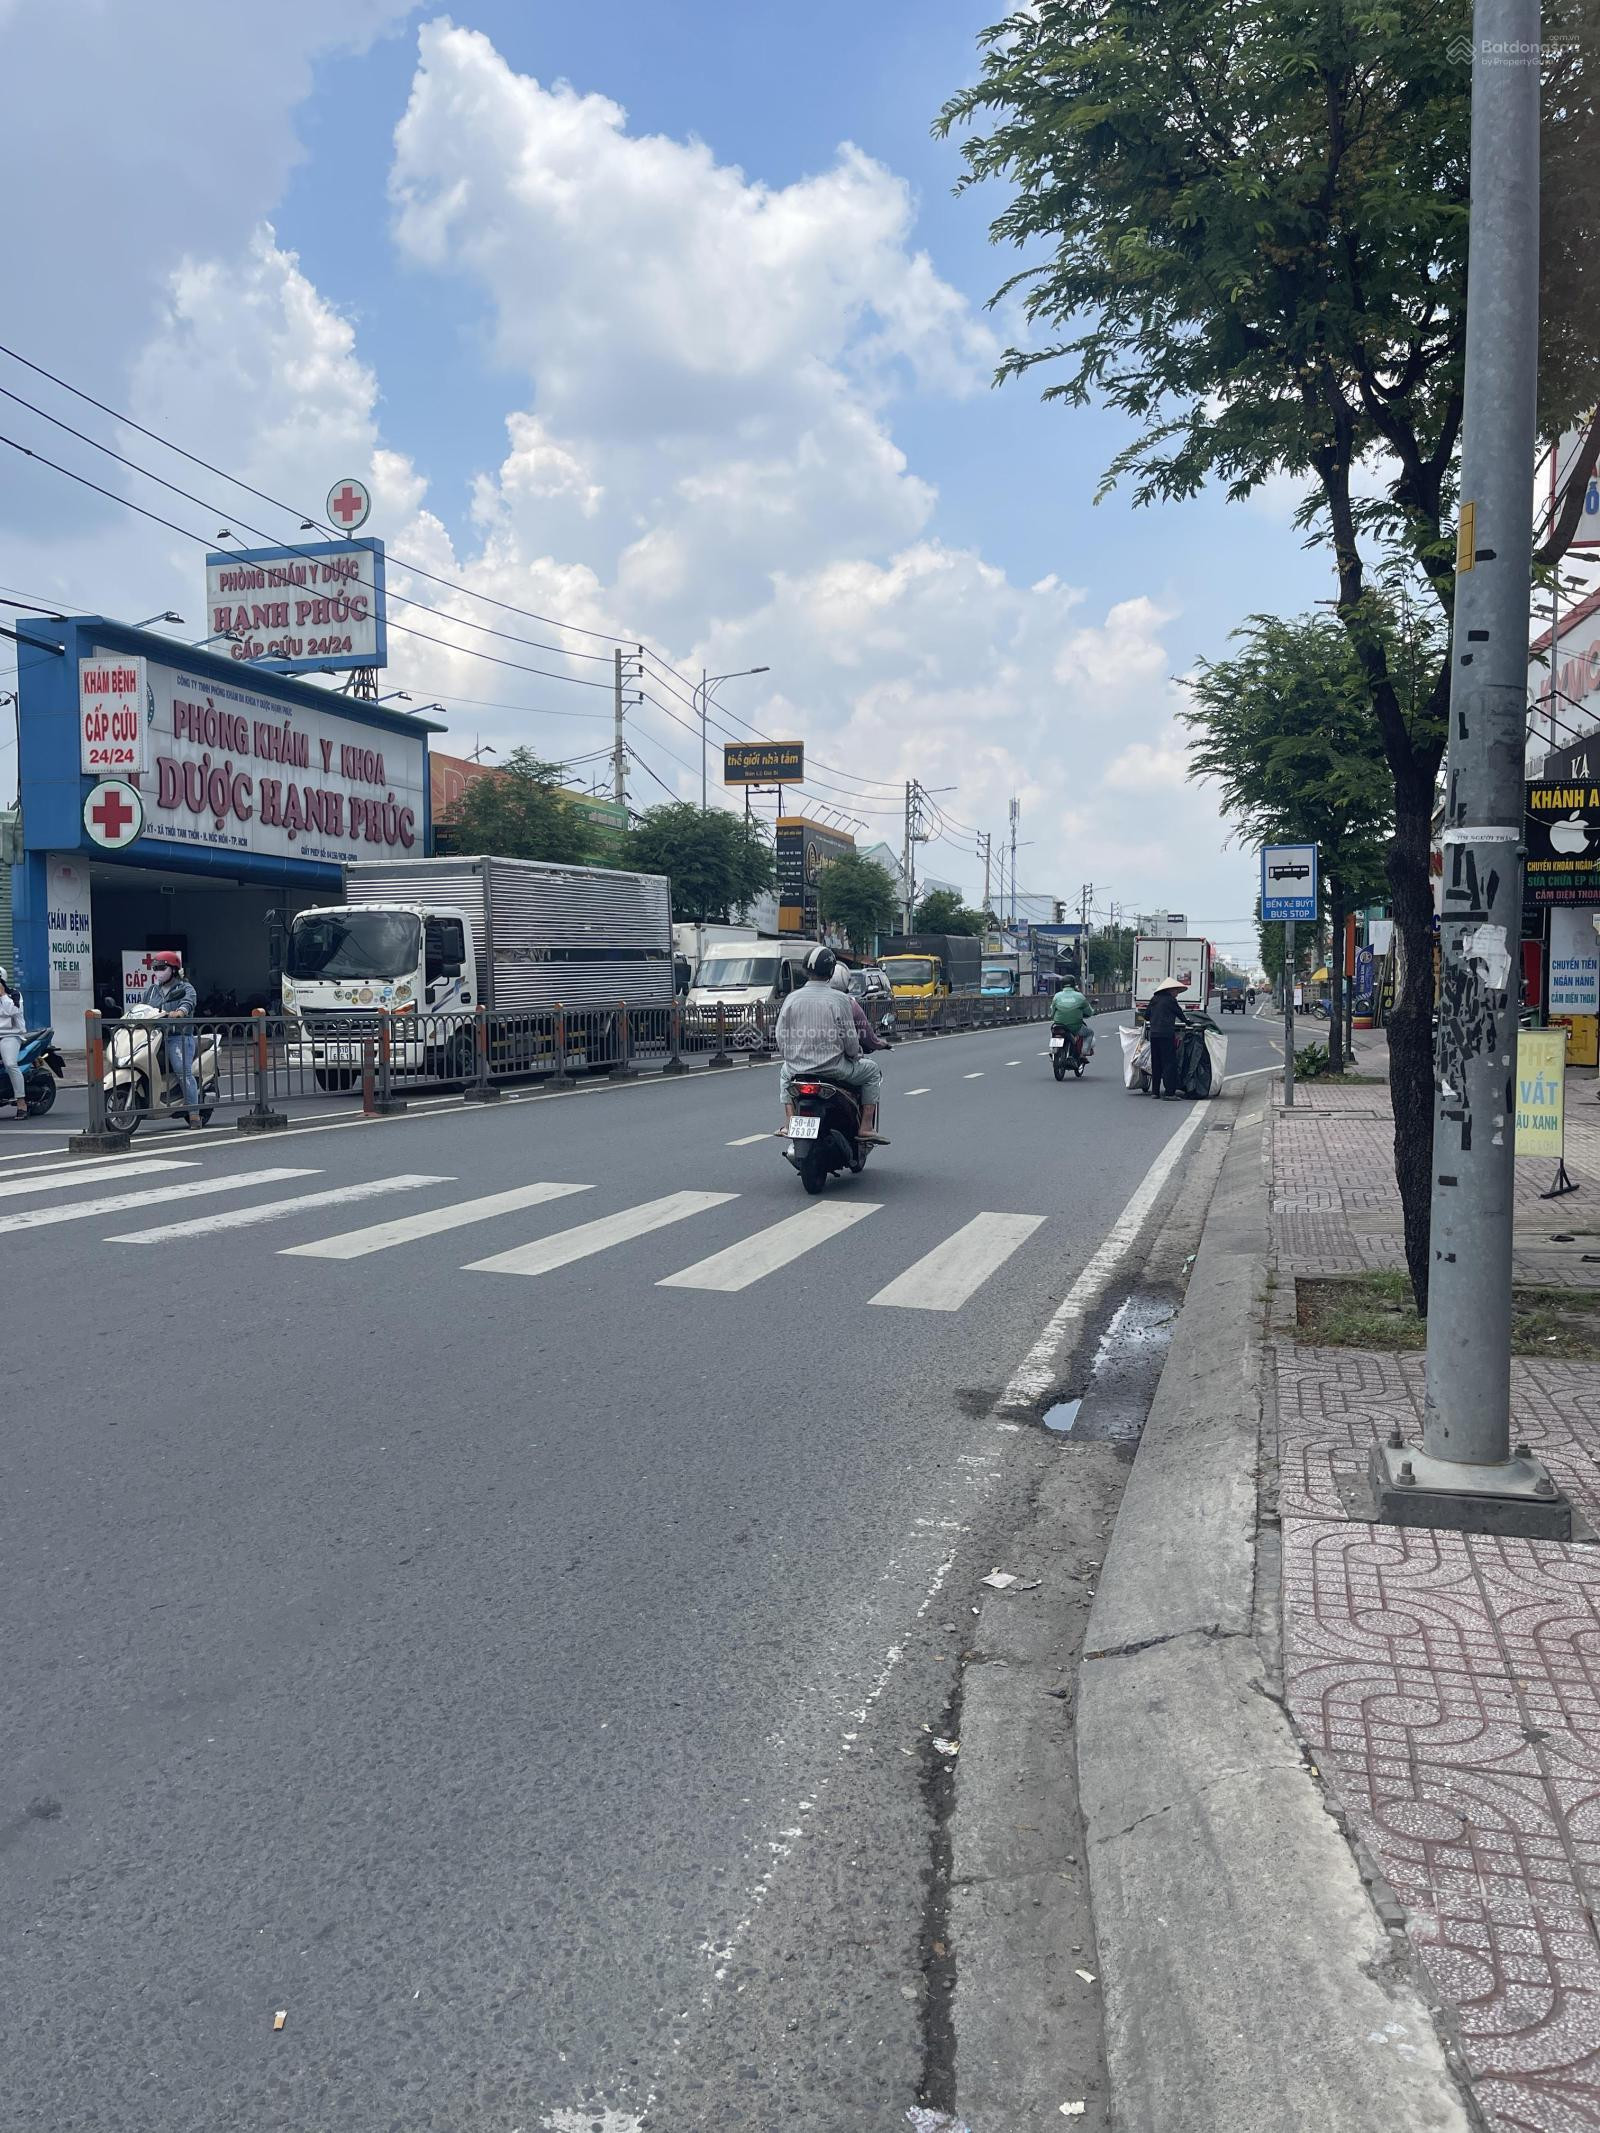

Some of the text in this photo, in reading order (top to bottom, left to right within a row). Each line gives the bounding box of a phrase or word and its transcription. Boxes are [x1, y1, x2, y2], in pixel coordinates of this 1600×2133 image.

[220, 557, 359, 592] PHÒNG KHÁM Y DƯỢC
[213, 589, 368, 636] HẠNH PHÚC
[308, 635, 353, 655] 24/24
[84, 665, 137, 699] KHÁM BỆNH
[191, 680, 198, 690] TY
[85, 704, 137, 742] CẤP CỨU
[174, 697, 250, 755] PHÒNG
[253, 720, 309, 769] KHÁM
[320, 738, 334, 774] Y
[341, 743, 386, 787] KHOA
[89, 748, 135, 765] 24/24
[727, 750, 742, 766] thế
[743, 751, 761, 768] giới
[762, 751, 779, 765] nhà
[157, 752, 253, 831] DƯỢC
[260, 778, 344, 841] HẠNH
[349, 792, 415, 849] PHÚC
[1531, 786, 1585, 809] KHÁNH
[1283, 900, 1294, 908] XE
[1295, 898, 1314, 908] BUÝT
[70, 909, 90, 937] BỆNH
[1270, 910, 1310, 918] BUS STOP
[52, 940, 90, 954] NGƯỜI LỚN
[69, 961, 80, 971] EM
[1551, 957, 1580, 970] CHUYỂN
[125, 968, 148, 988] CẤP
[1553, 974, 1595, 987] NGÂN HÀNG
[125, 992, 142, 1004] KHÁ
[1520, 1071, 1559, 1105] VẮT
[1516, 1110, 1558, 1131] ẬU XANH
